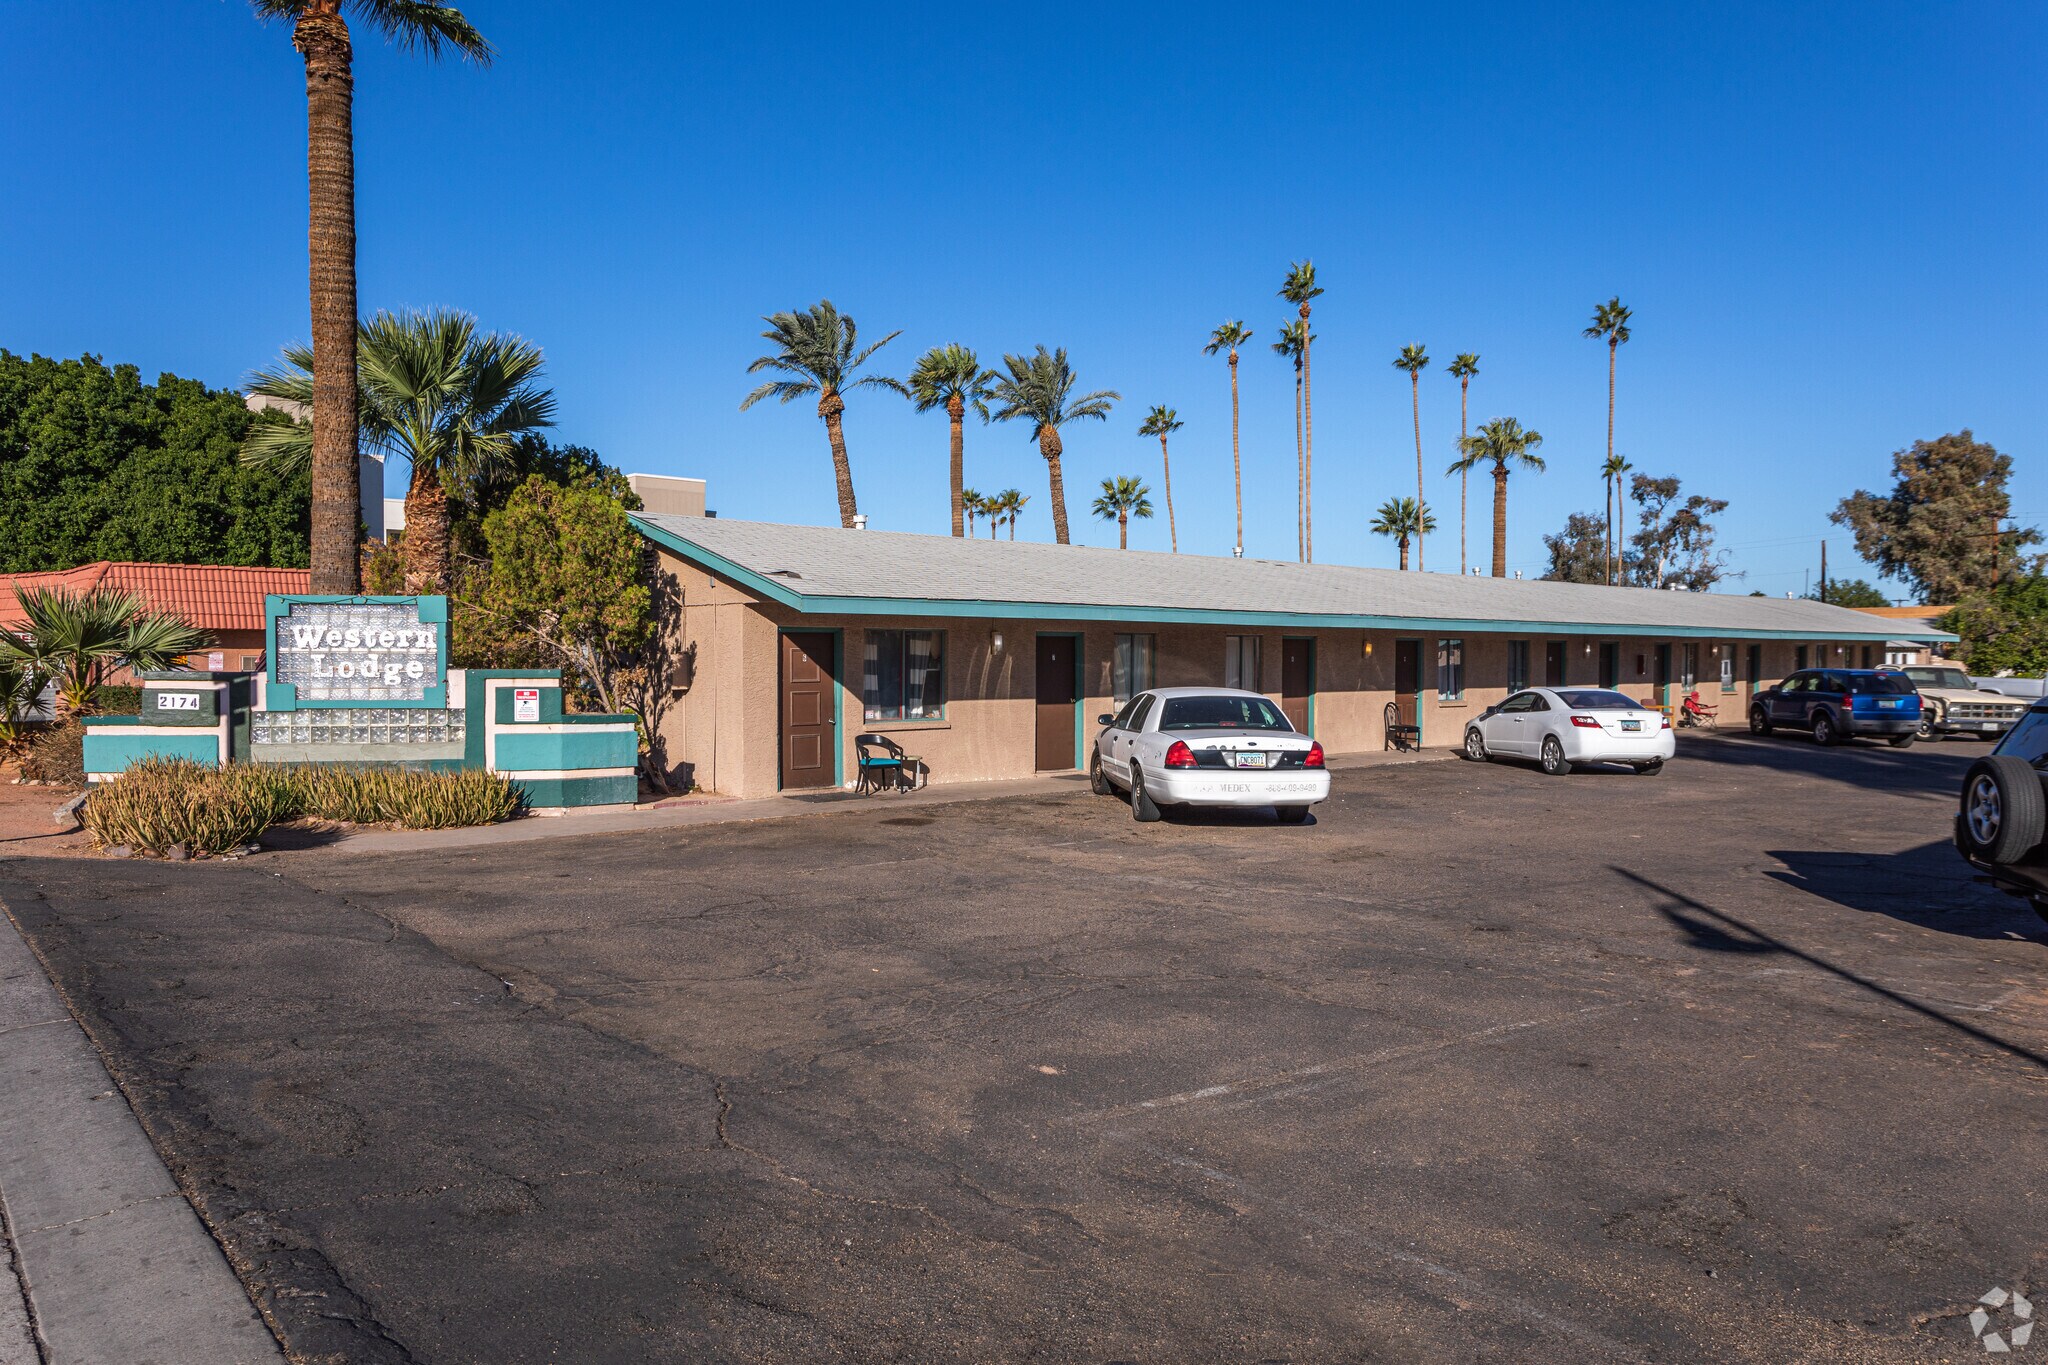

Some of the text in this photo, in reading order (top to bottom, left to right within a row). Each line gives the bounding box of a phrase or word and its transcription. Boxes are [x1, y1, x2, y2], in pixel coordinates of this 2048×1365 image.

[290, 624, 437, 649] Western
[310, 654, 425, 686] Lodge
[160, 696, 197, 708] 2174
